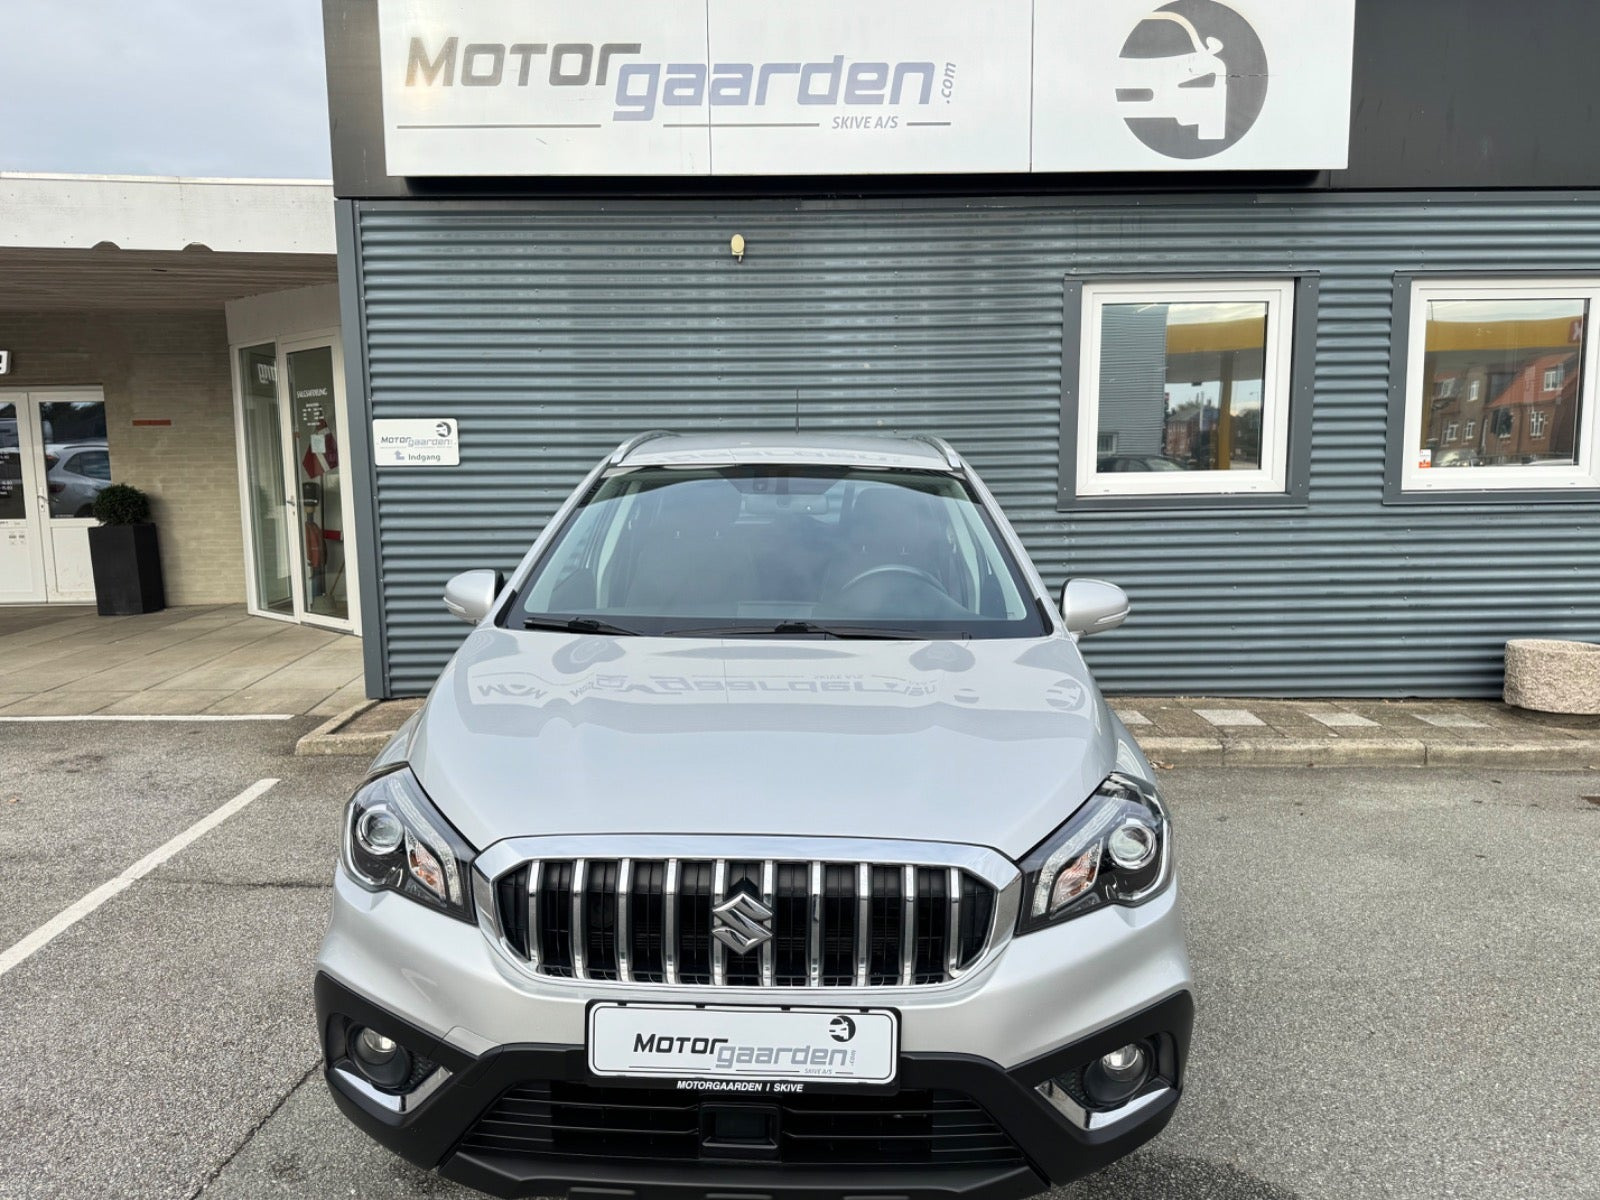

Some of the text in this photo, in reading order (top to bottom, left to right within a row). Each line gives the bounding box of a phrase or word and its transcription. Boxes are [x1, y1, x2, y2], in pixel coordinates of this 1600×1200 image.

[941, 61, 957, 104] .com
[831, 116, 898, 129] SKIVE A/S
[408, 453, 441, 462] Indgang
[804, 1067, 822, 1075] SKIVE
[676, 1080, 763, 1092] MOTORGAARDEN
[773, 1083, 804, 1093] SKIVE
